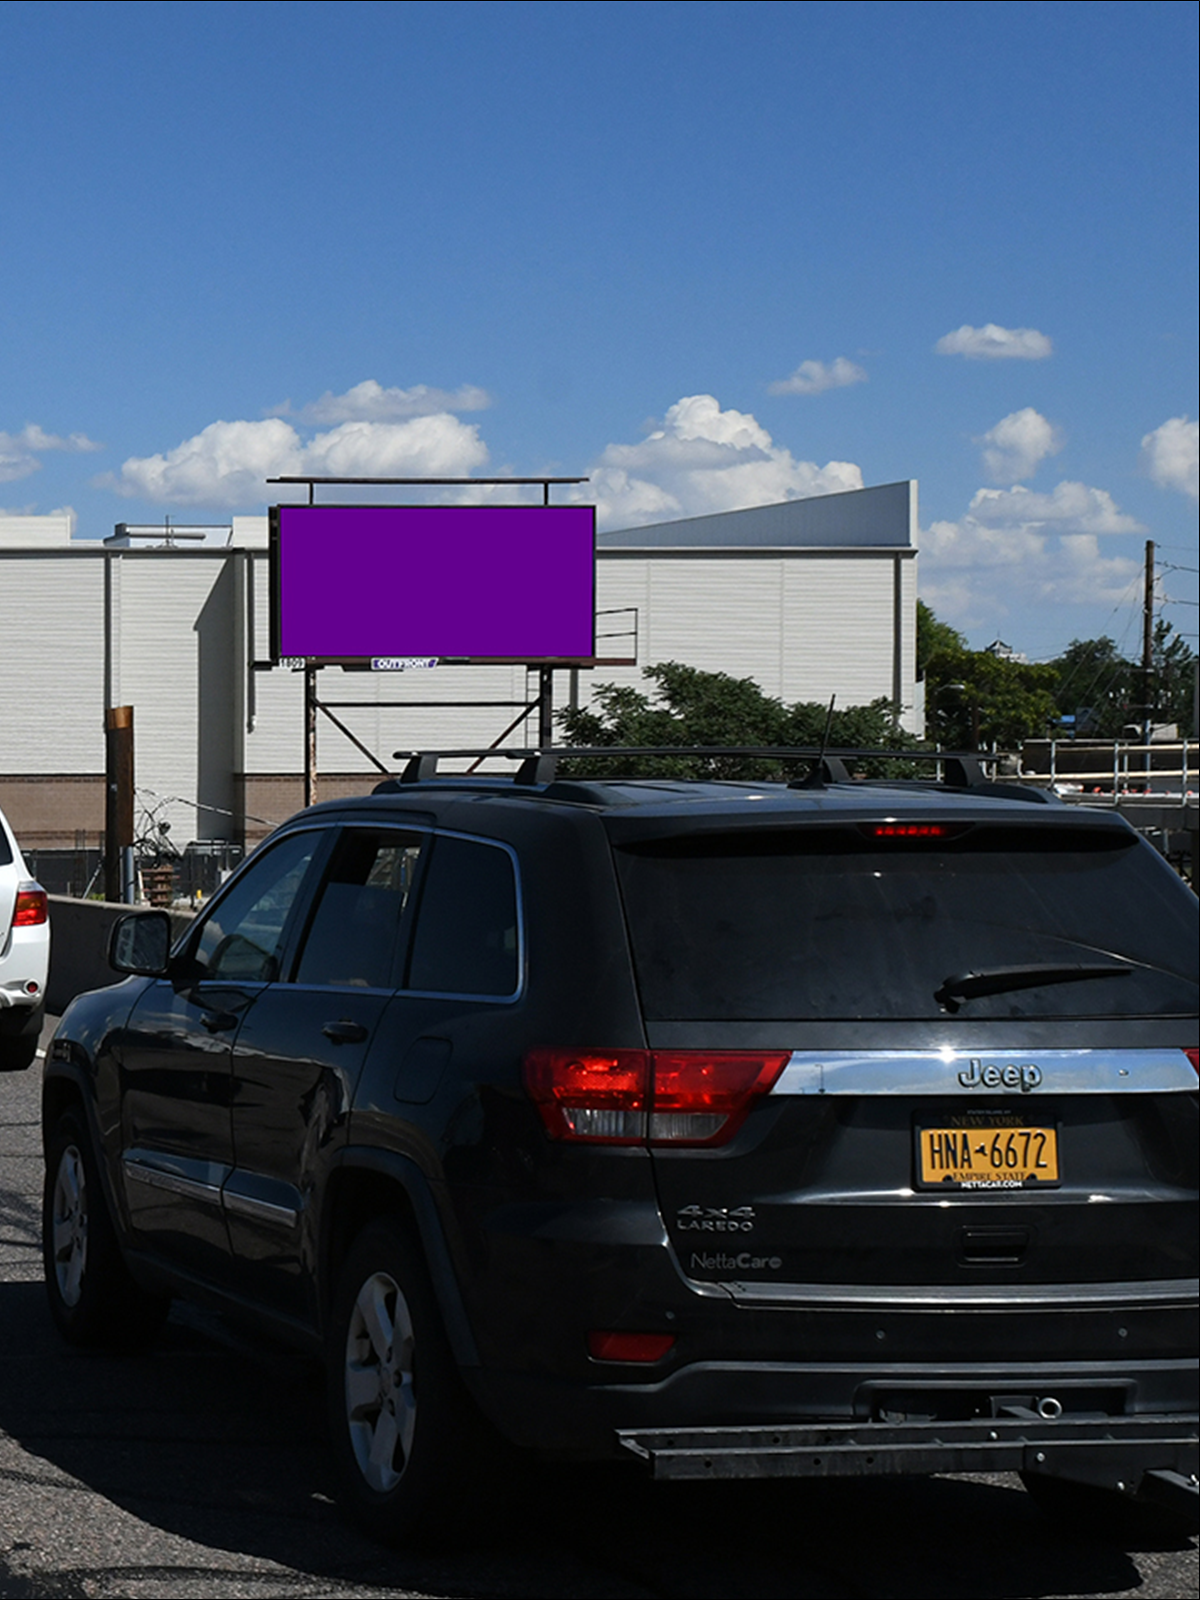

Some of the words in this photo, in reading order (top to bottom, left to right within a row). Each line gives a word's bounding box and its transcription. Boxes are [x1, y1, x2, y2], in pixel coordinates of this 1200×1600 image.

[958, 1058, 1042, 1092] Jeep
[951, 1116, 986, 1127] NEW
[988, 1115, 1025, 1126] YORK
[929, 1132, 972, 1169] HNA
[990, 1131, 1048, 1169] 6672
[953, 1171, 992, 1181] EMPIRE
[995, 1171, 1027, 1180] STATE
[677, 1205, 756, 1219] 4x4
[677, 1220, 754, 1232] LAREDO
[690, 1251, 783, 1270] NettaCare
